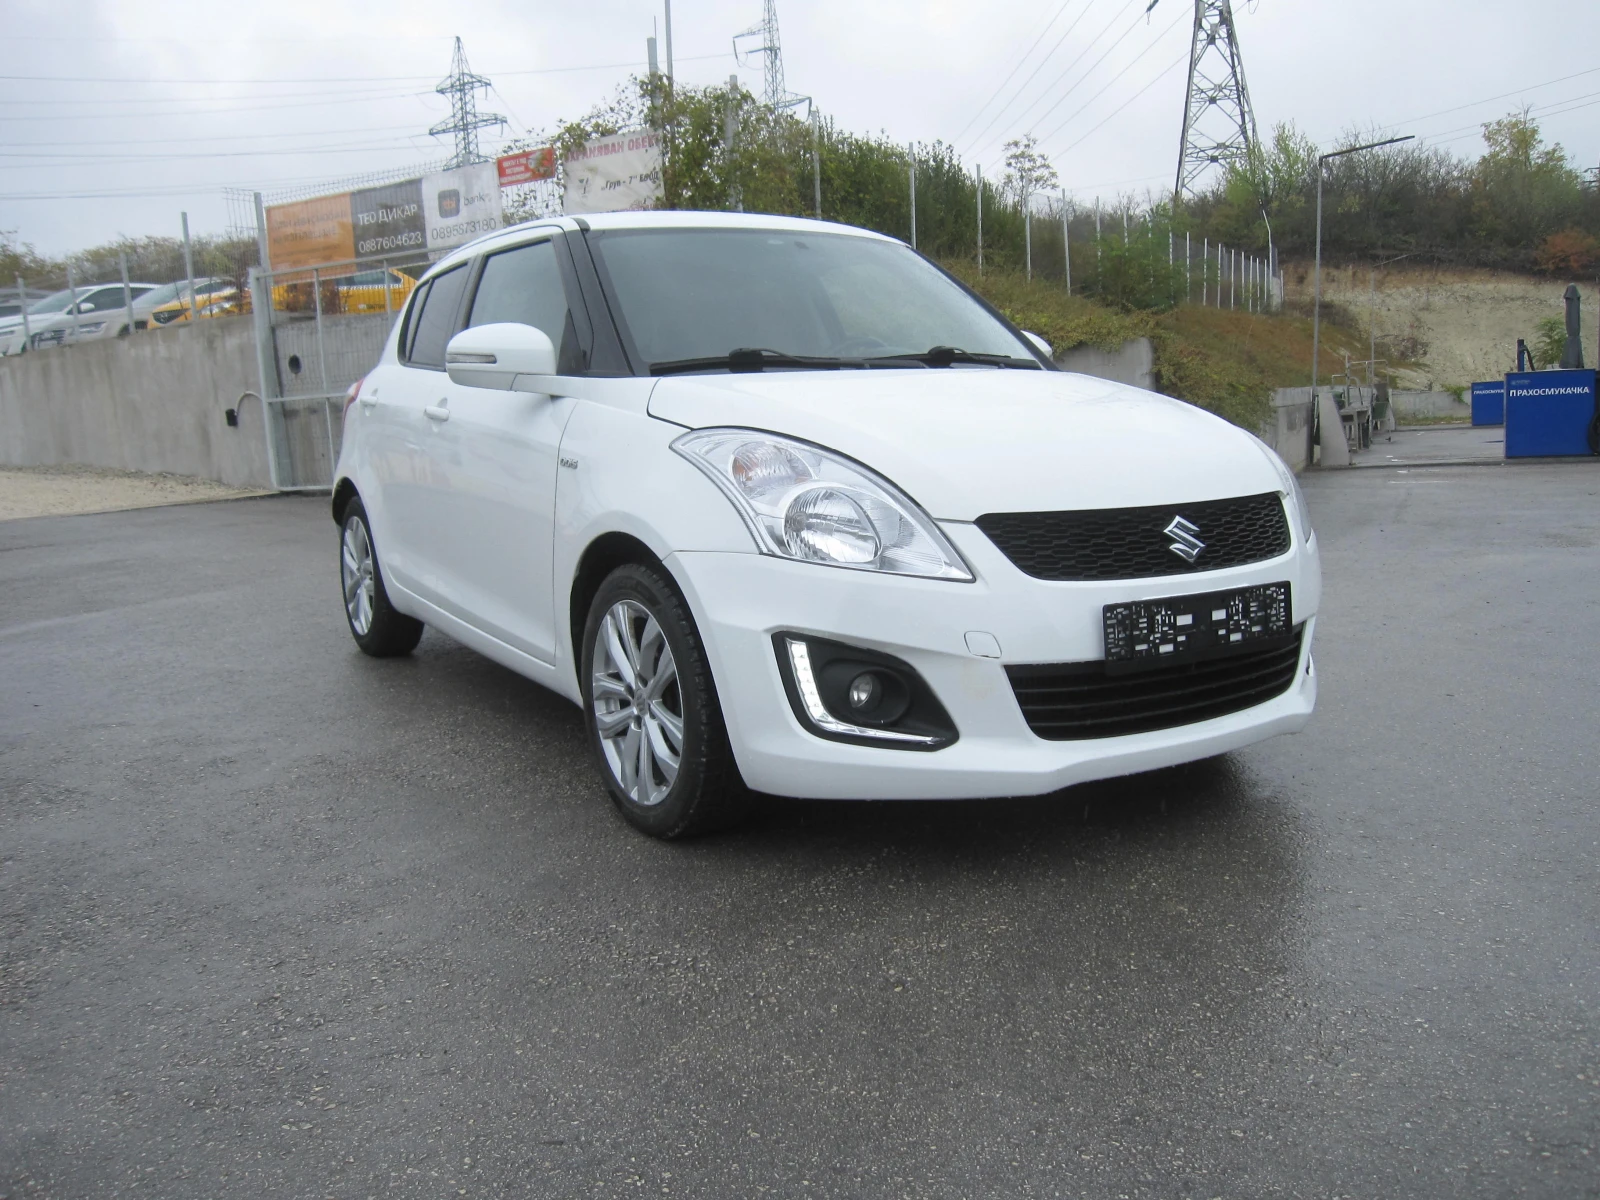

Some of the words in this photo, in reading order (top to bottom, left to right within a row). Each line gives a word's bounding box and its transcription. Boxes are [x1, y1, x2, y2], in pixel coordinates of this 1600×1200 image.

[564, 140, 624, 163] ХРАНЯВАН
[463, 192, 485, 206] bank
[358, 211, 376, 226] ТЕО
[378, 204, 418, 224] ДИКАР
[358, 231, 422, 254] 0887604623
[1509, 386, 1590, 396] ПРАХОСМУКАЧКА
